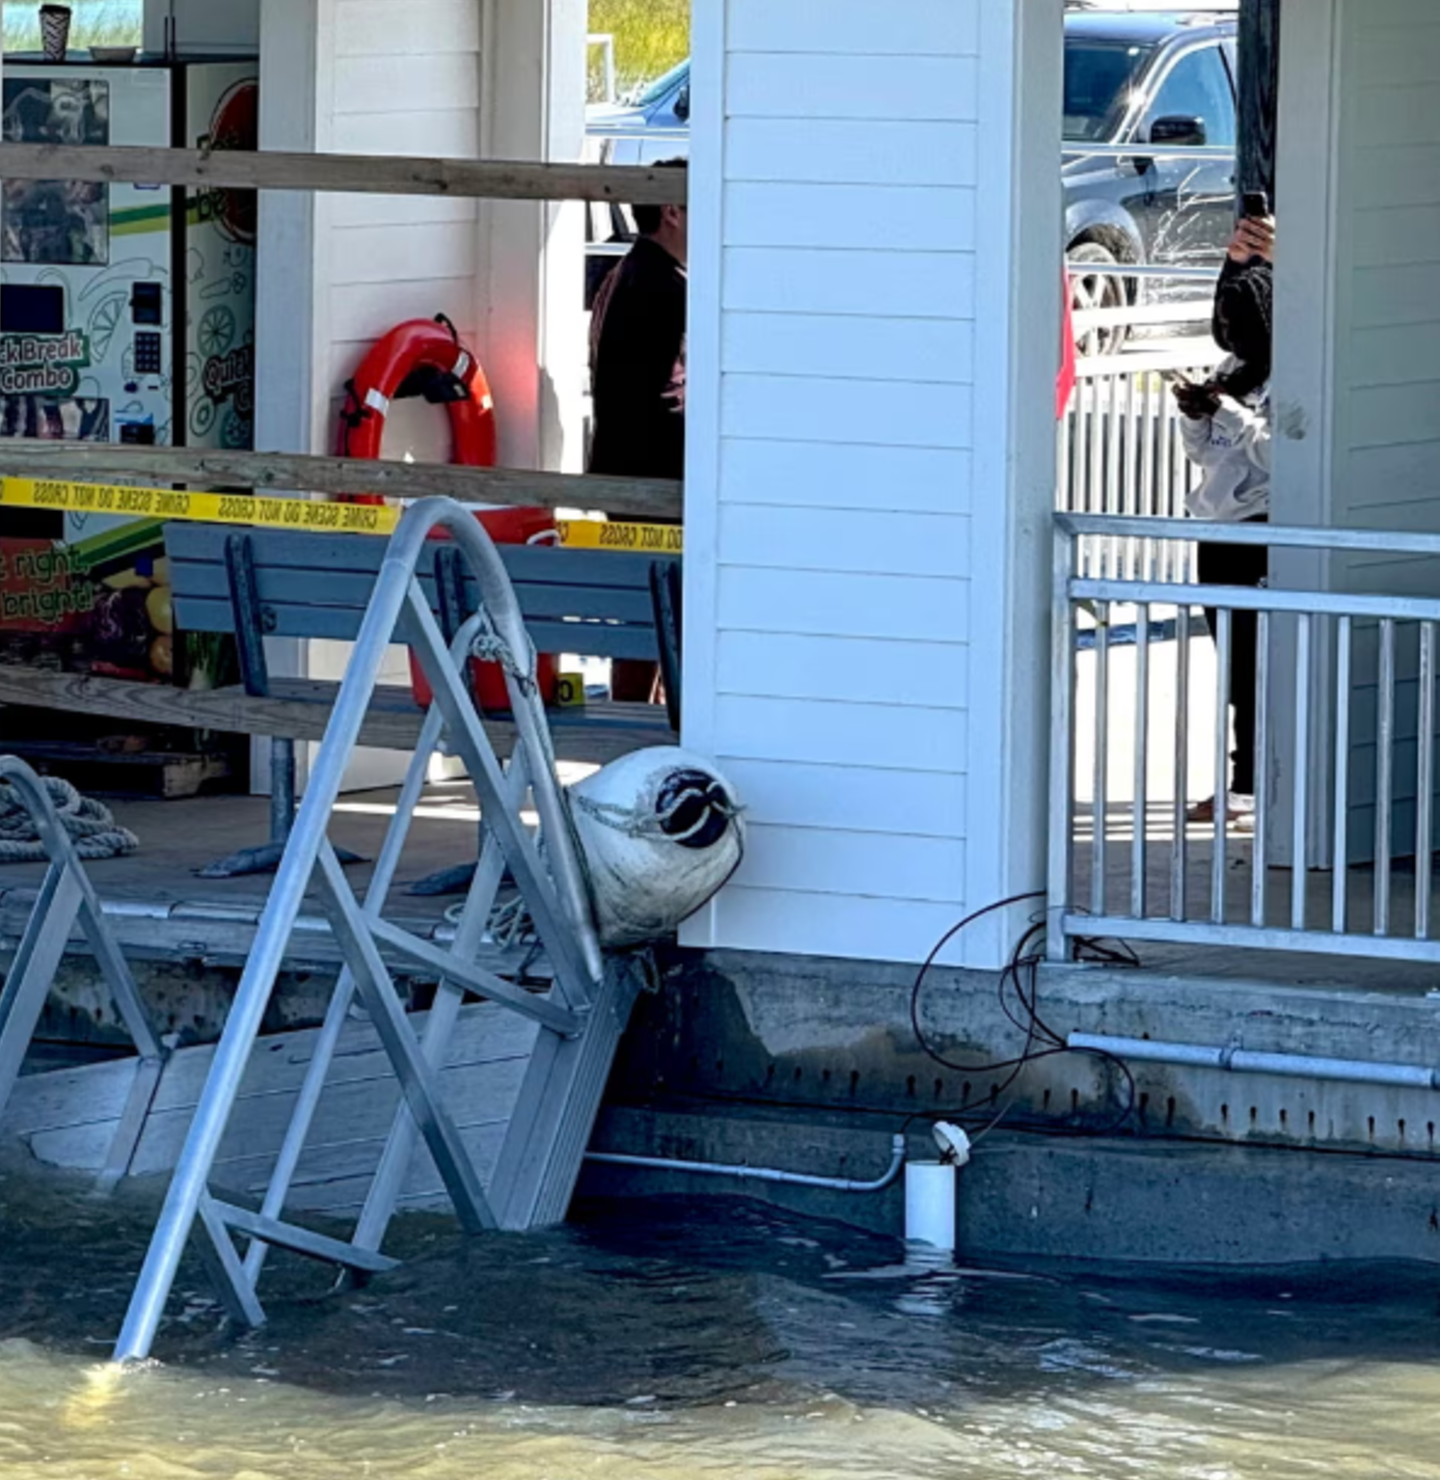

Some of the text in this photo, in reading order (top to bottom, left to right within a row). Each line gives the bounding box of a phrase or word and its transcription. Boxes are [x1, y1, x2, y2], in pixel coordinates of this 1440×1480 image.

[23, 334, 81, 361] Break
[1, 367, 72, 391] Combo
[16, 545, 90, 582] right,
[3, 583, 93, 623] bright!
